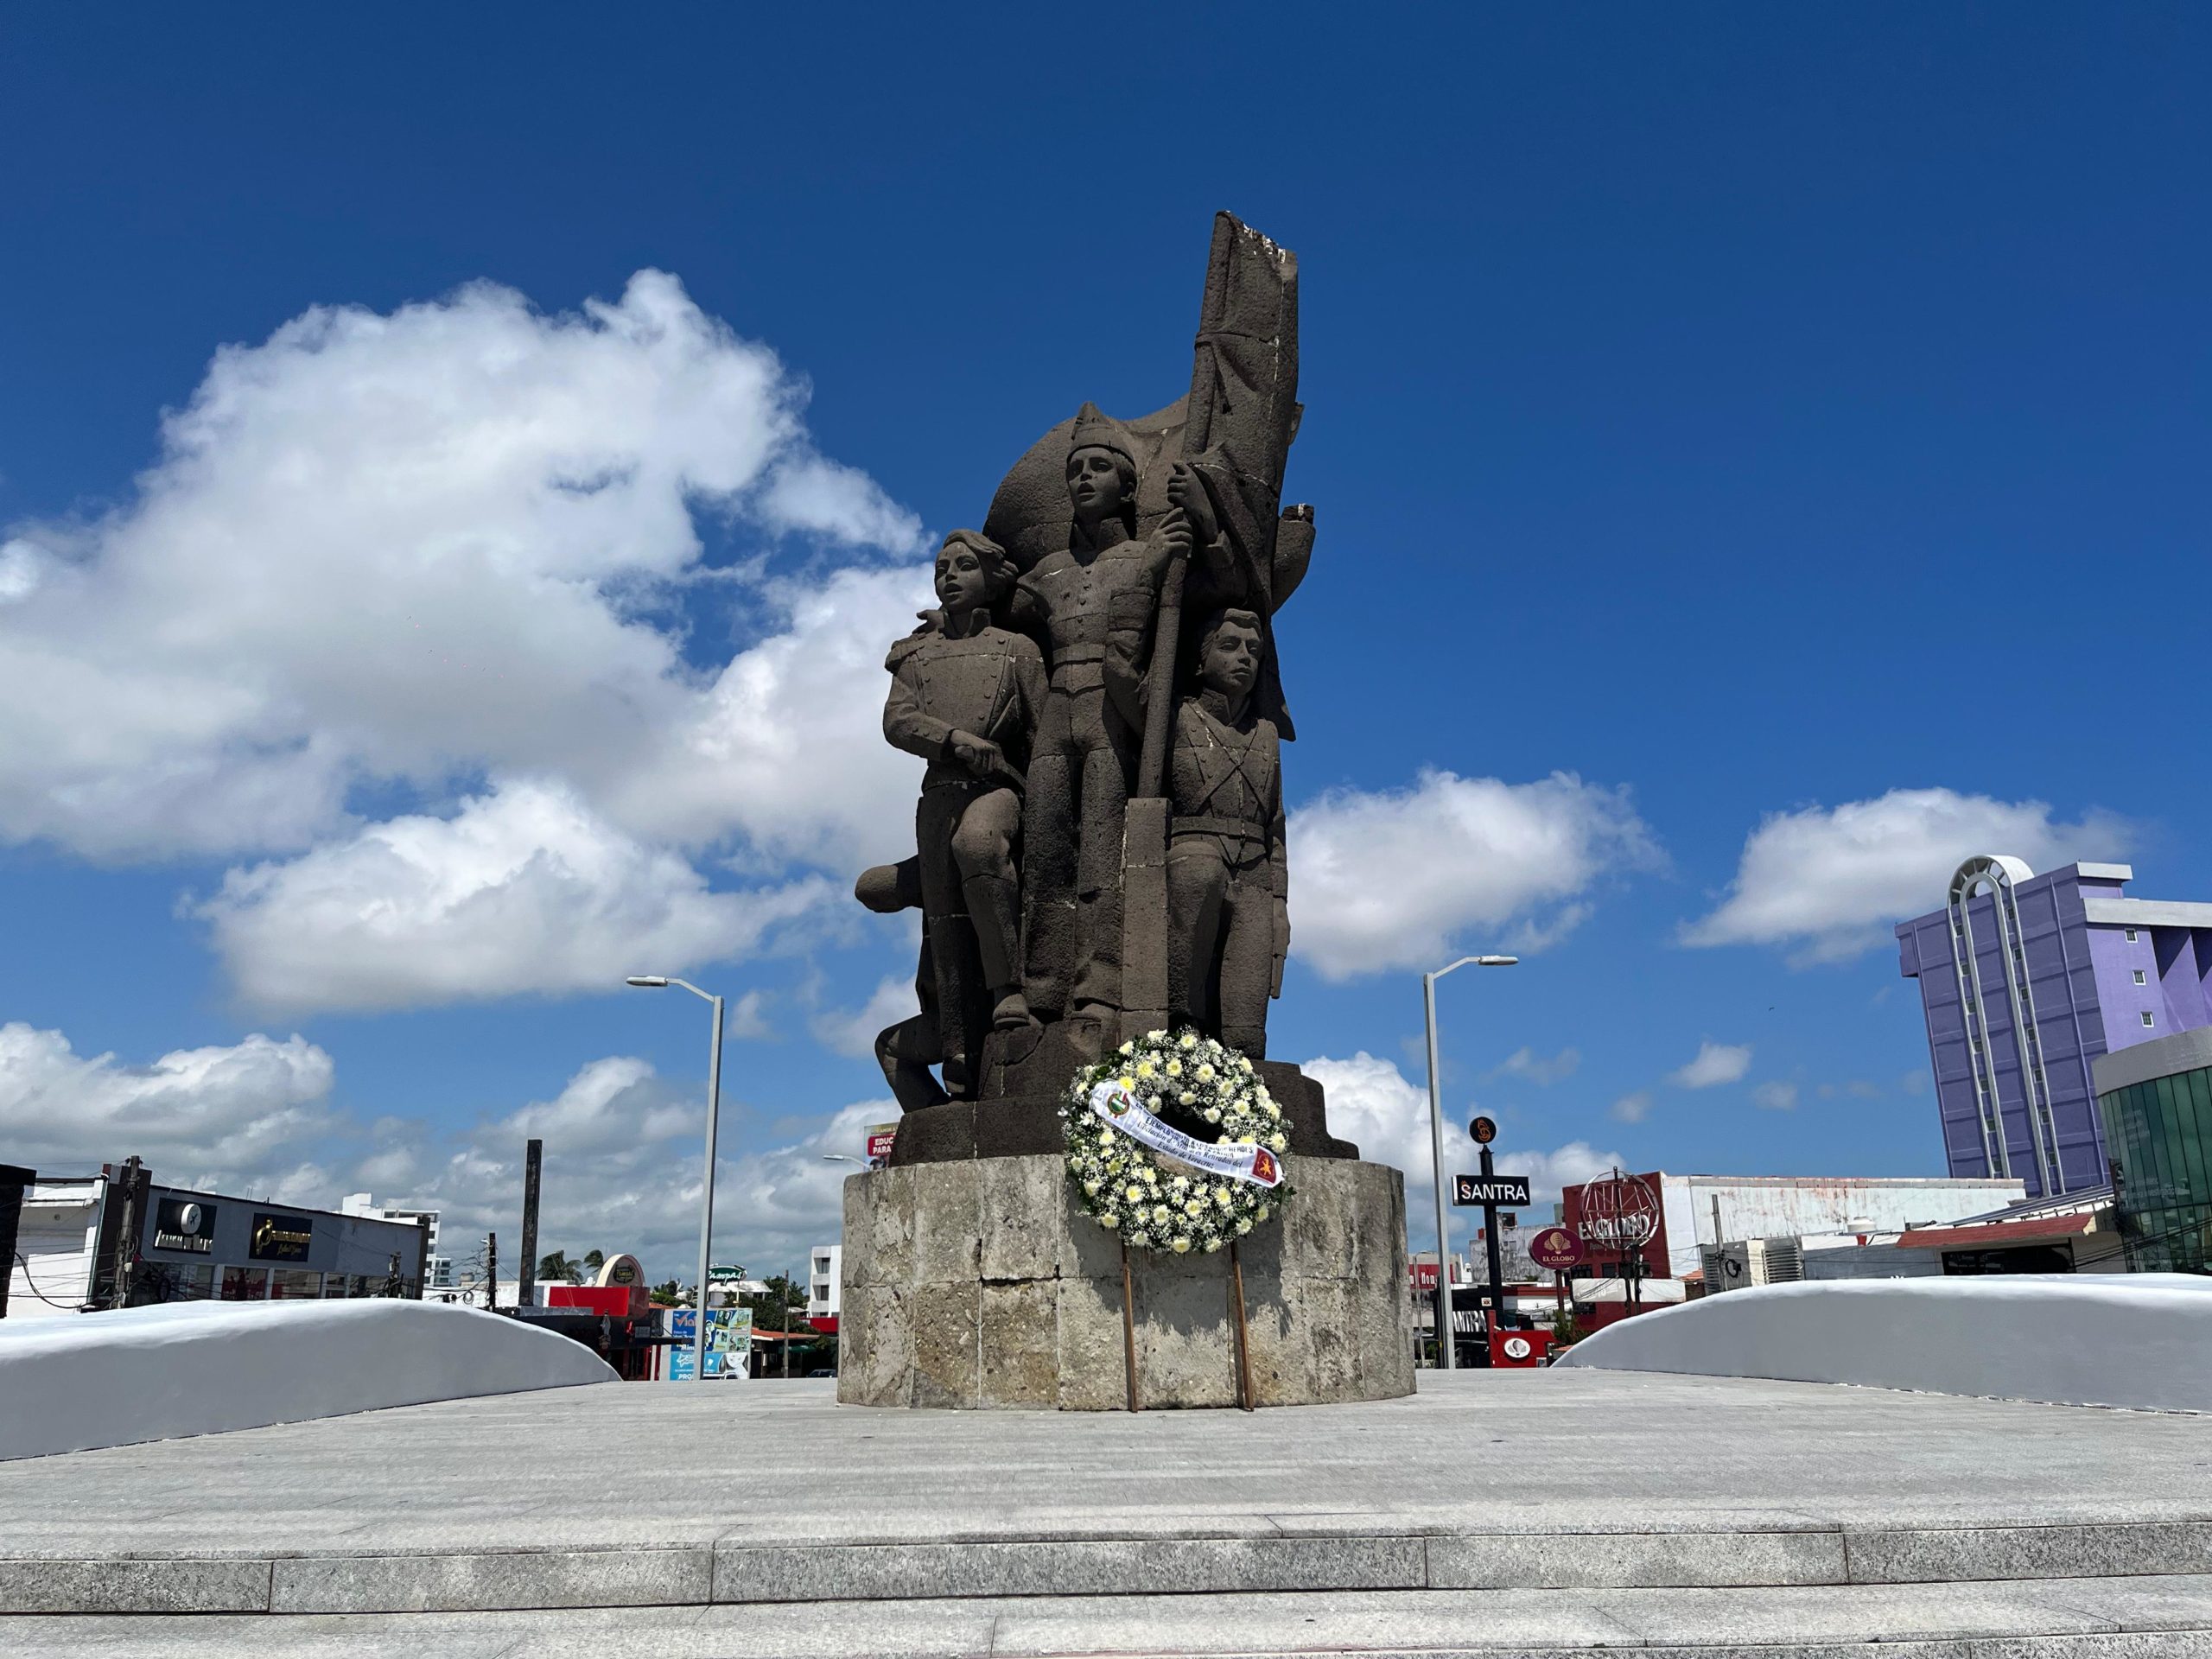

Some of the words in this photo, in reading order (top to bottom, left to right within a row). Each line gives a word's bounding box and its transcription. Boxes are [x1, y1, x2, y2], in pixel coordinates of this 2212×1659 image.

[873, 1145, 892, 1154] PARA
[1158, 1141, 1178, 1154] Estado
[1178, 1150, 1187, 1159] de
[1232, 1159, 1243, 1168] del
[1461, 1183, 1528, 1201] SANTRA
